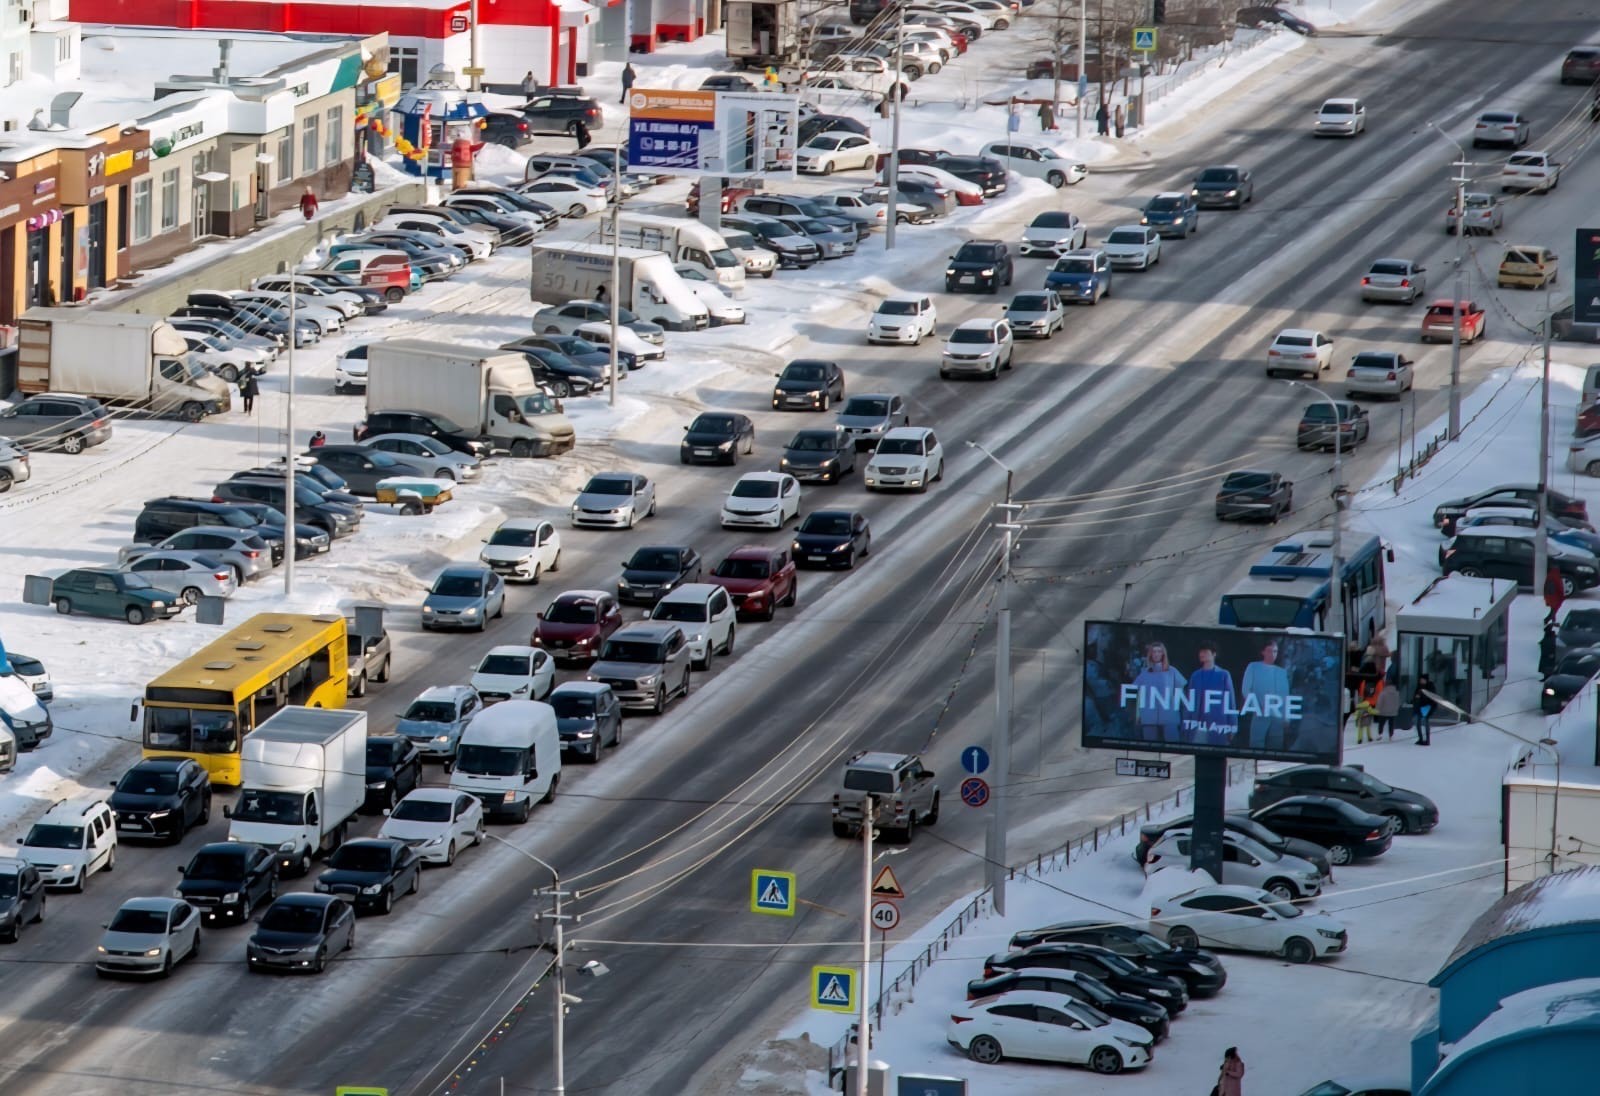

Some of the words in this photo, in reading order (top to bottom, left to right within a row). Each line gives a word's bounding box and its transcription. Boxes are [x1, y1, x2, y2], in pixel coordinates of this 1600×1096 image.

[1120, 683, 1196, 712] FINN
[1204, 689, 1303, 720] FLARE
[1183, 719, 1207, 732] ТРЦ
[875, 909, 893, 922] 40
